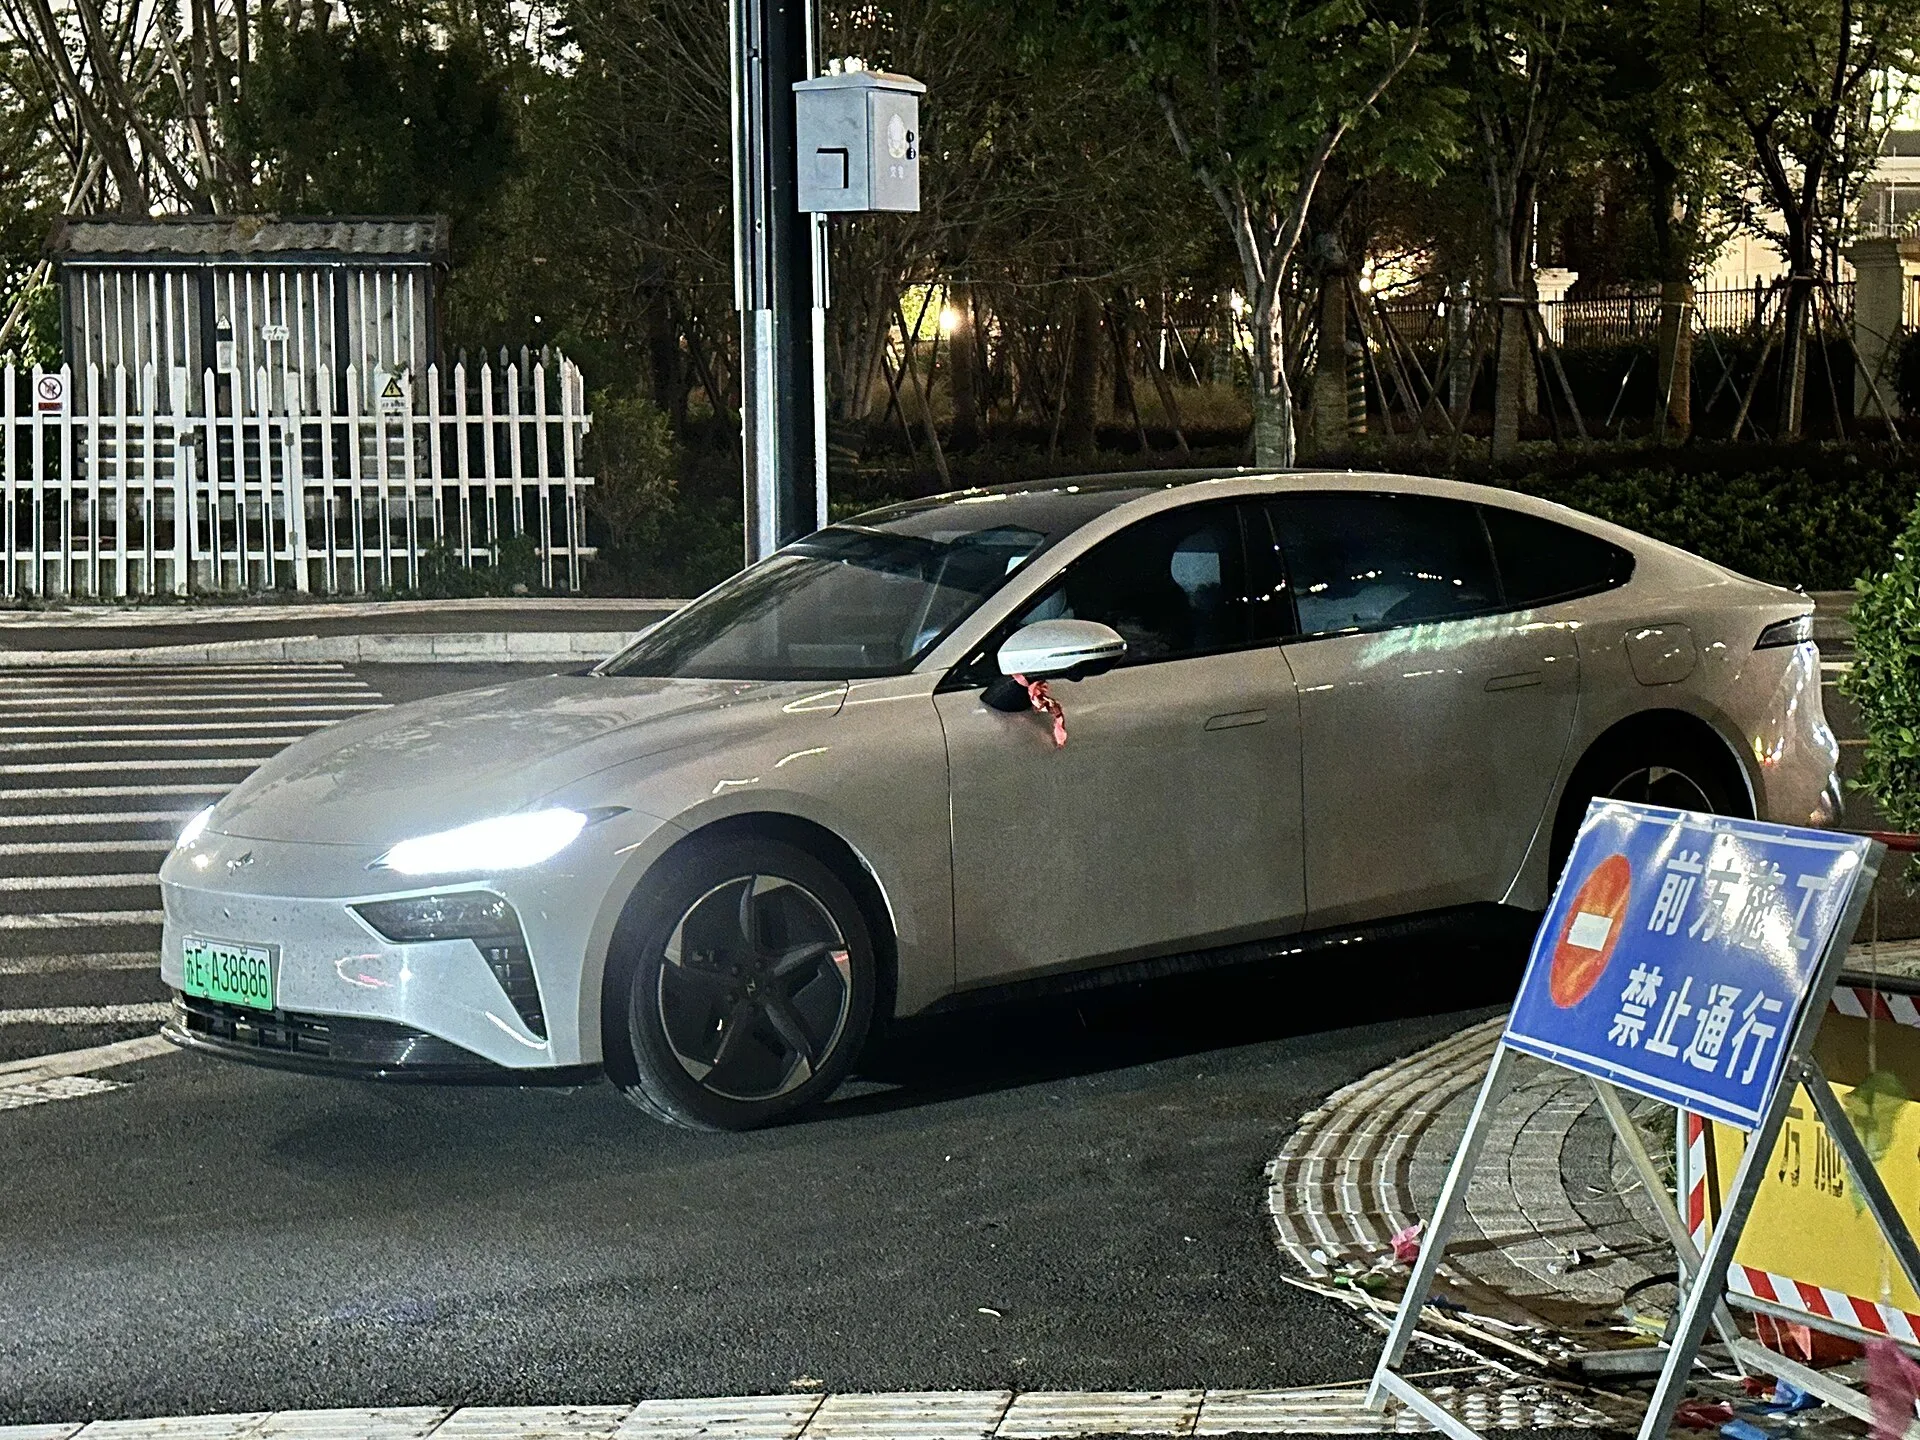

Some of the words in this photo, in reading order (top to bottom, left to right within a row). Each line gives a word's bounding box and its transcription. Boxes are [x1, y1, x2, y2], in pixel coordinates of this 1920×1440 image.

[1647, 849, 1831, 951] 前方施工
[1608, 962, 1783, 1085] 禁止通行
